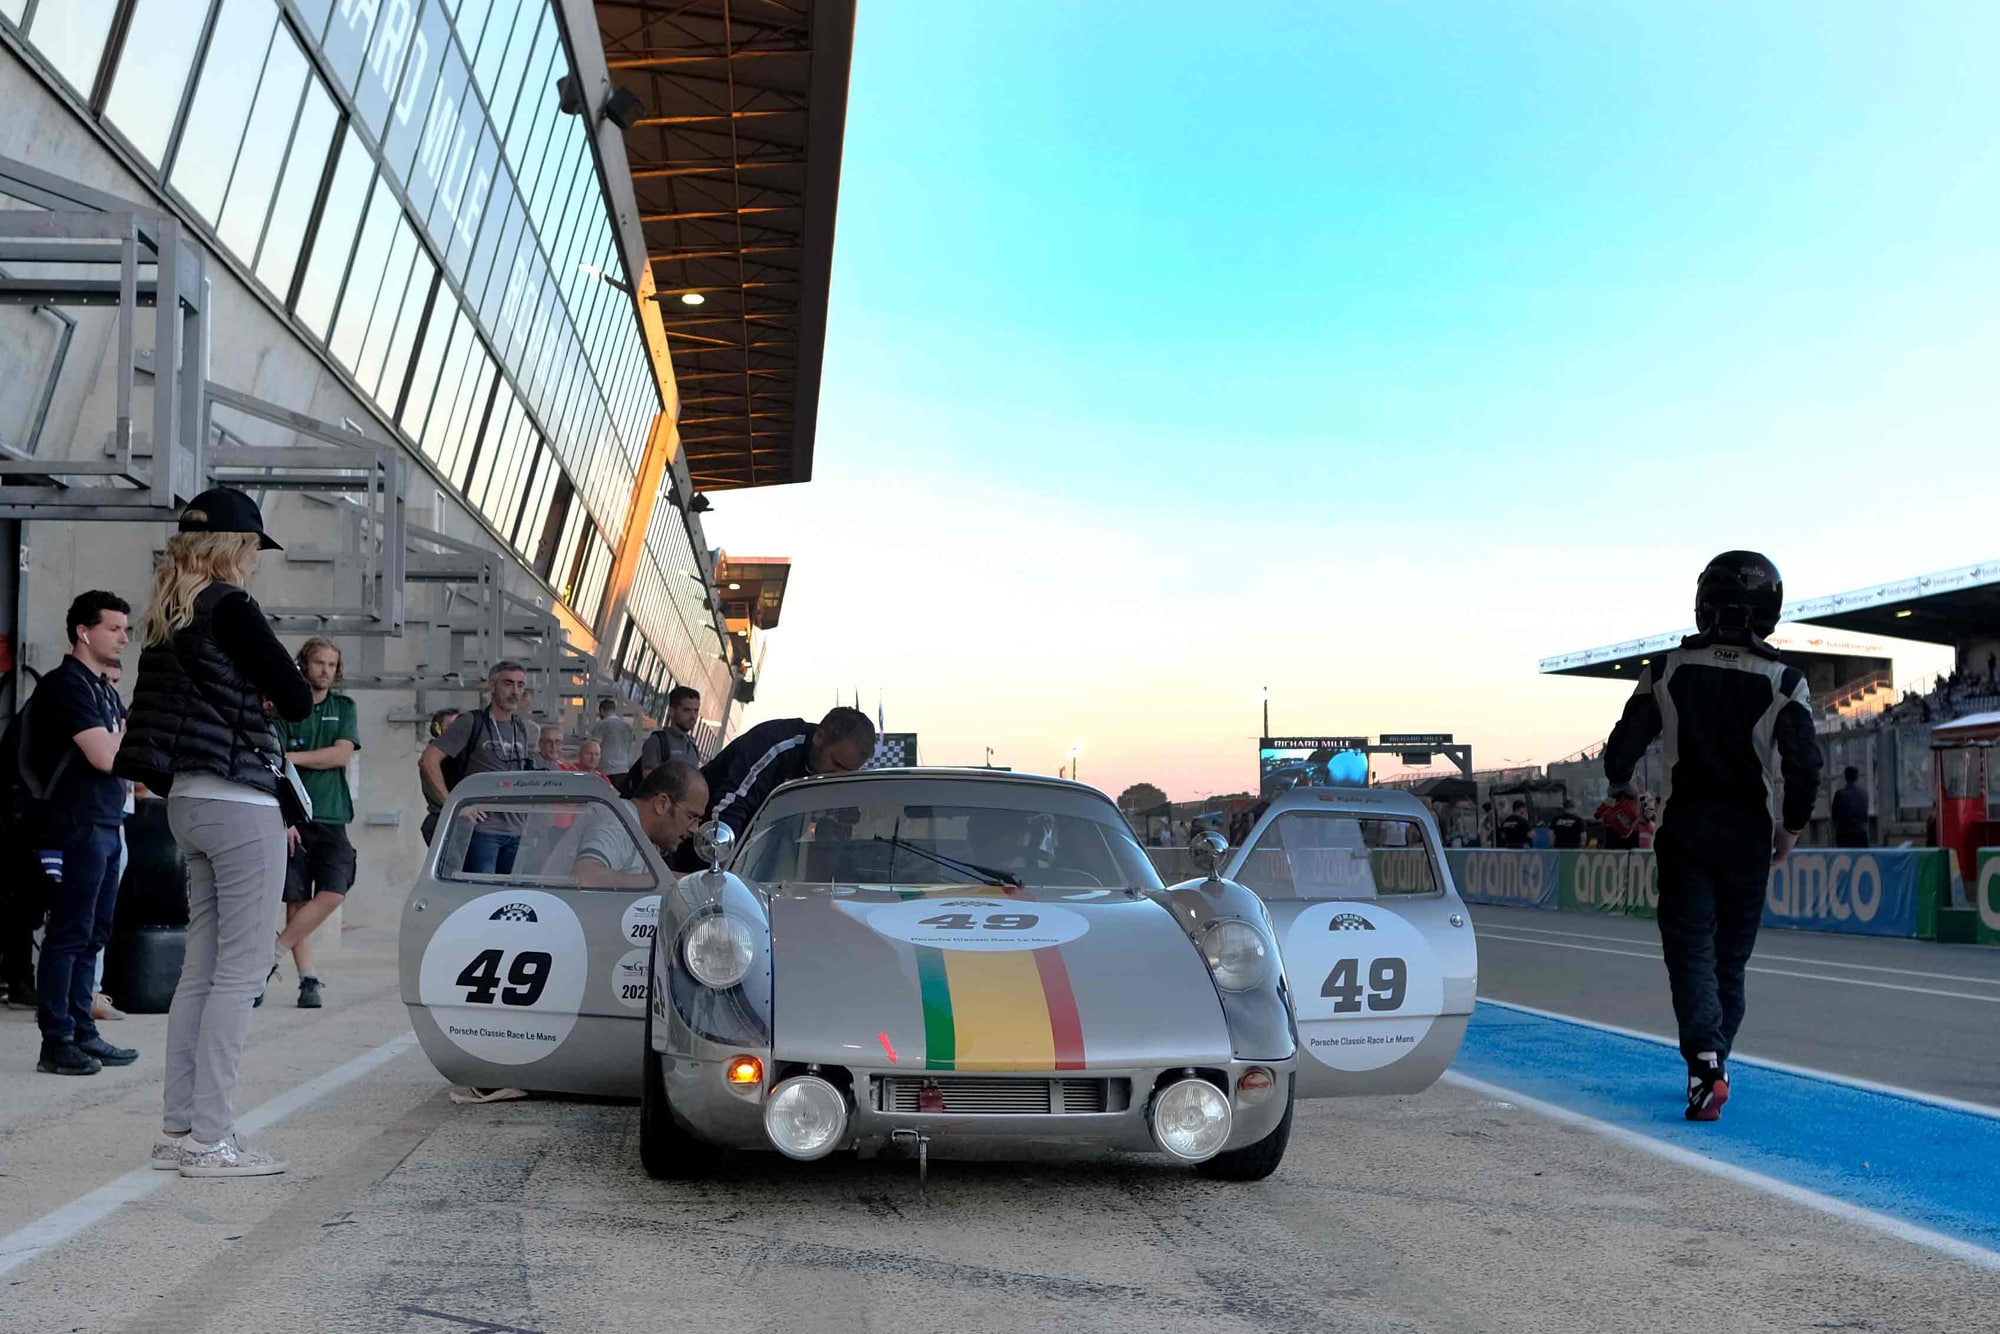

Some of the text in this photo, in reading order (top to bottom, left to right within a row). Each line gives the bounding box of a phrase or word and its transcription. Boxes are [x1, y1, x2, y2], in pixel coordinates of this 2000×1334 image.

[421, 76, 489, 249] MILLE
[1713, 650, 1739, 660] OMP
[1274, 740, 1352, 748] RICHARD MILLE
[1382, 853, 1433, 891] aramc
[1466, 851, 1543, 897] aramco
[1575, 852, 1659, 908] aramc
[1766, 854, 1881, 922] amco
[631, 924, 656, 938] 202
[918, 914, 1039, 930] 49
[455, 949, 552, 1006] 49
[1320, 957, 1408, 1013] 49
[622, 984, 649, 999] 202
[449, 1026, 557, 1041] Porsche Classic Race Le Mans
[1310, 1038, 1339, 1046] Porsche
[1341, 1037, 1365, 1046] Classic
[1367, 1036, 1385, 1044] Race
